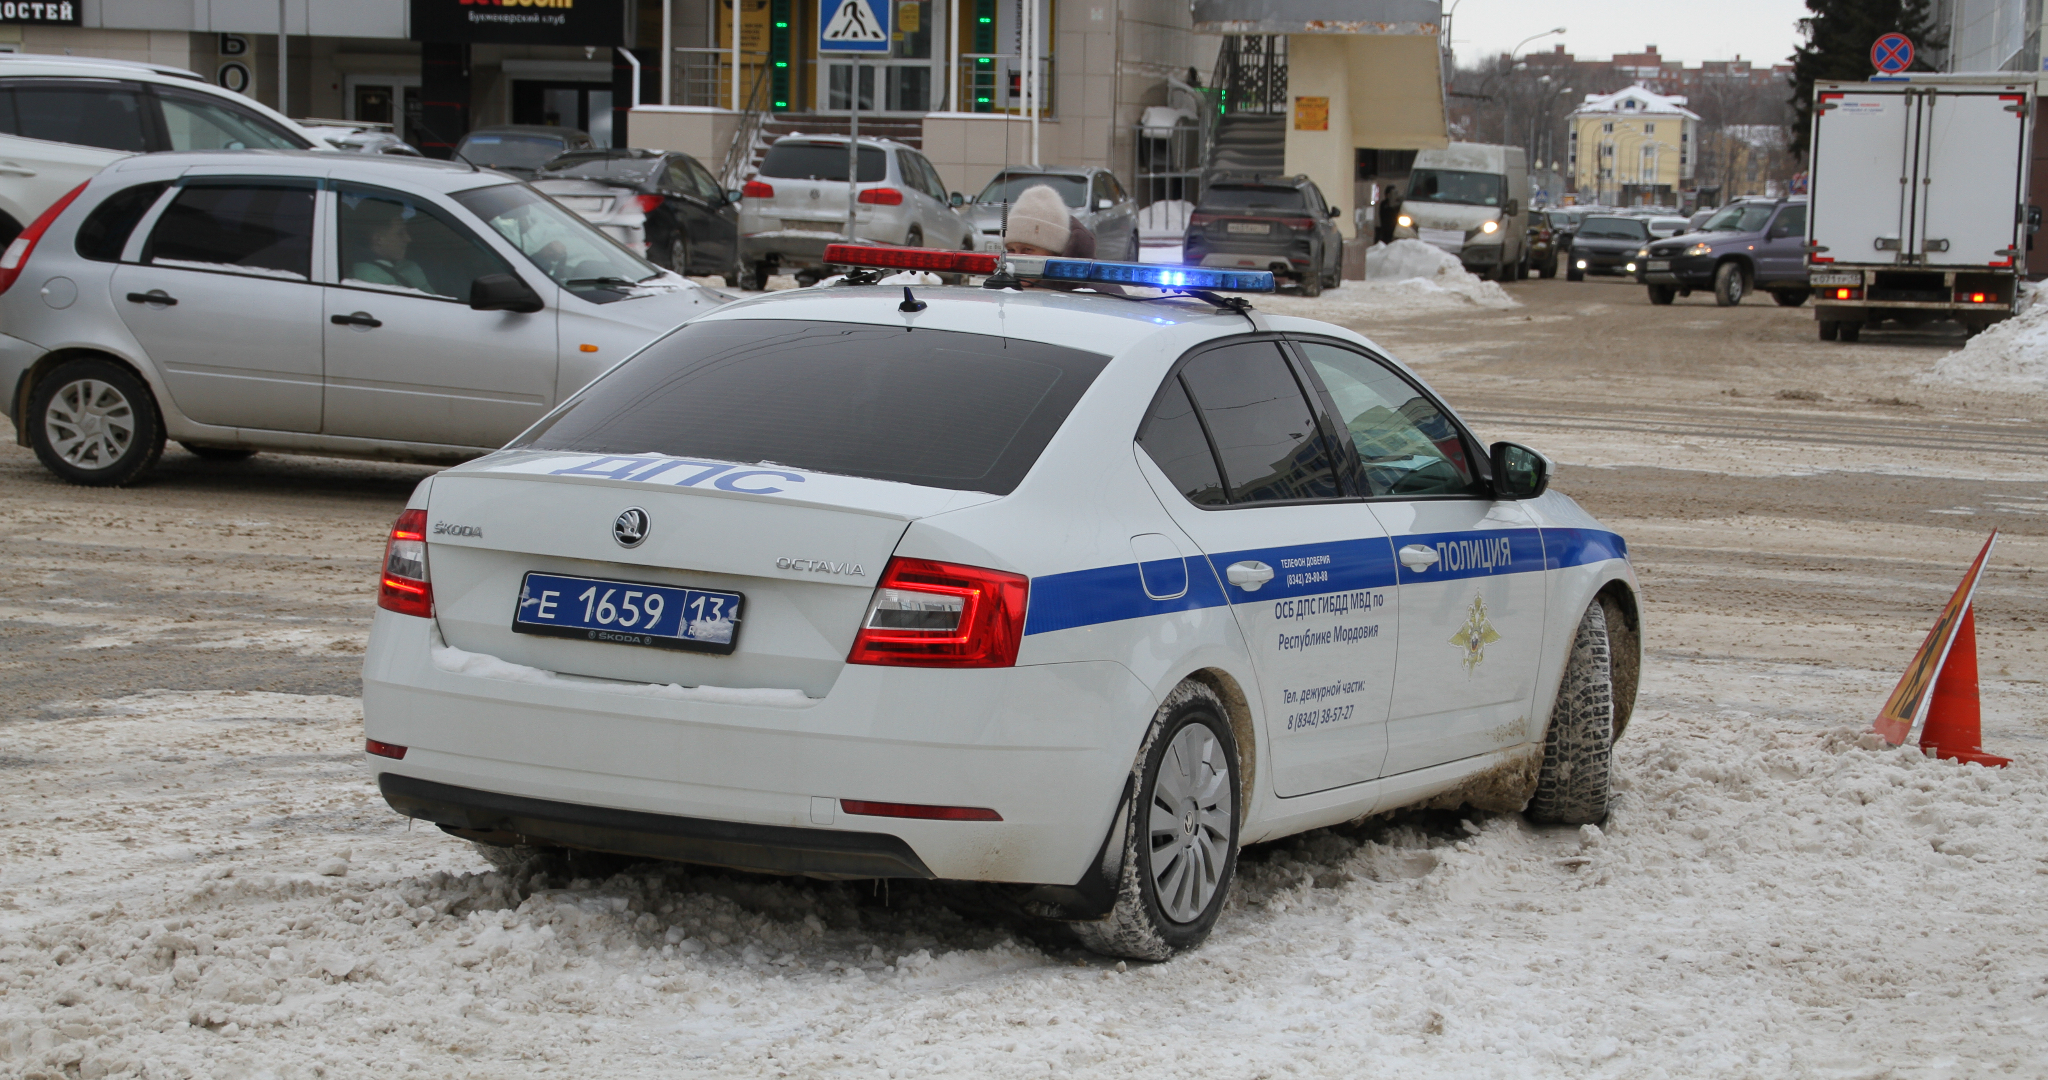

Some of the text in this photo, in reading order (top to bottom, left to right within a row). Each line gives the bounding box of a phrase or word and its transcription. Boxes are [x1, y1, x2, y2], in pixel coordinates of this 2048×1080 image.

[0, 1, 73, 20] ОСТЕЙ
[549, 456, 805, 494] ДПС
[776, 556, 865, 576] OCTAVIA
[1281, 554, 1330, 568] ТЕЛЕФОН ДОВЕРИЯ
[1437, 537, 1511, 573] ПОЛИЦИЯ
[1287, 573, 1304, 588] (8342)
[578, 586, 665, 629] 1659
[690, 595, 724, 622] 13
[1275, 591, 1384, 621] ОСБ ДПС ГИБДД МВД по
[598, 631, 641, 644] ŠKODA
[1279, 625, 1378, 652] Республике Мордовия
[1283, 680, 1366, 704] Тел. дежурной части:
[1287, 704, 1354, 732] 8 (8342) 38-57-27
